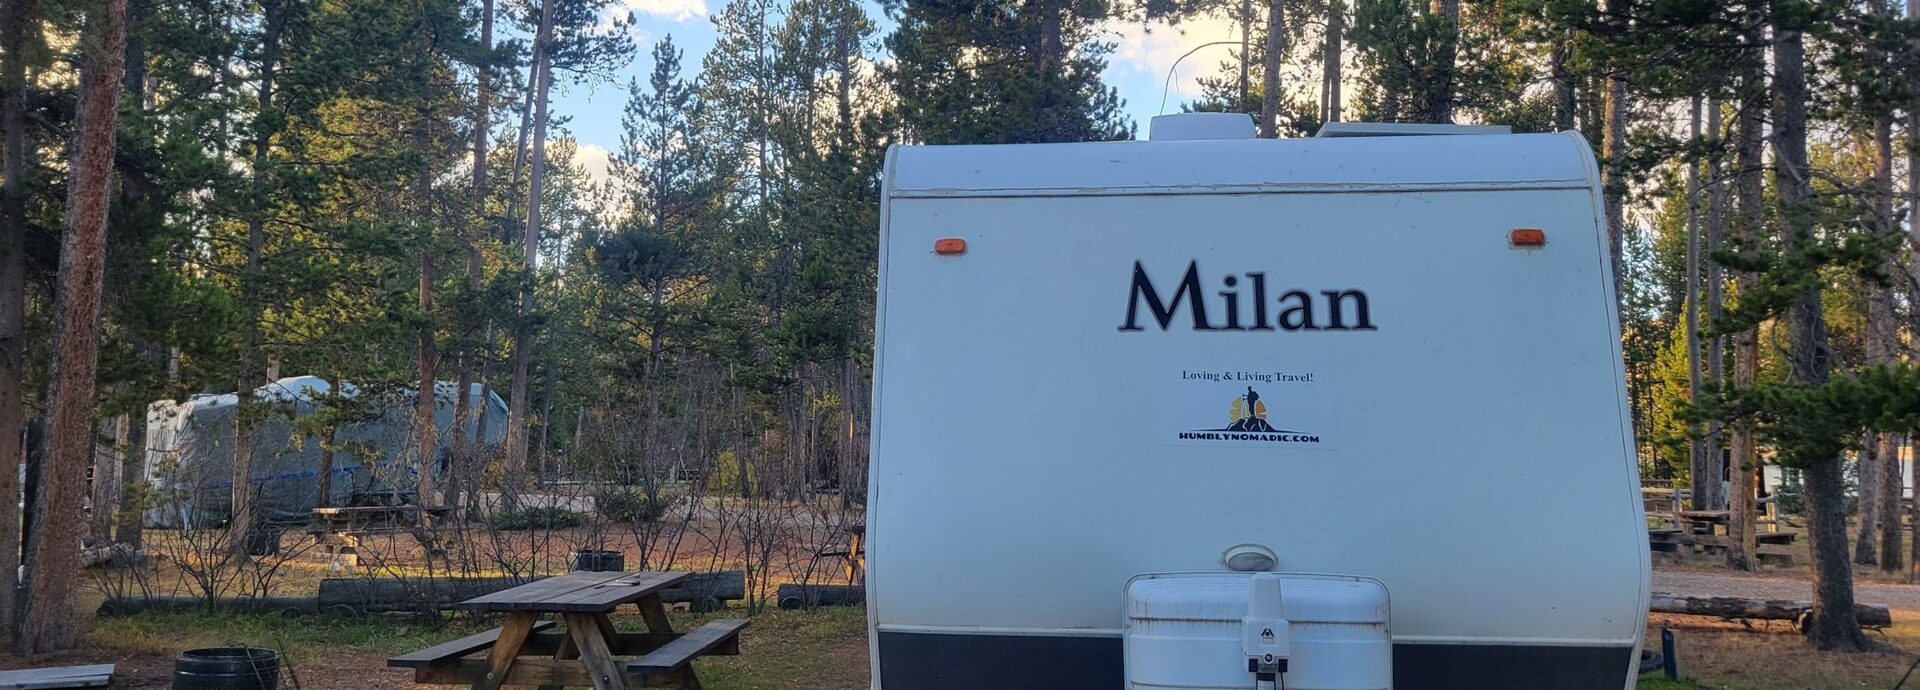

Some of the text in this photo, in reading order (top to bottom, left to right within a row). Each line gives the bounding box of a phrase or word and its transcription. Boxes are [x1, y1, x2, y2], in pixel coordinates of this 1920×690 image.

[1117, 258, 1378, 332] Milan
[1182, 370, 1314, 383] Loving & Living Travel!
[1178, 431, 1320, 443] HUMBLYNOMADIC.COM
